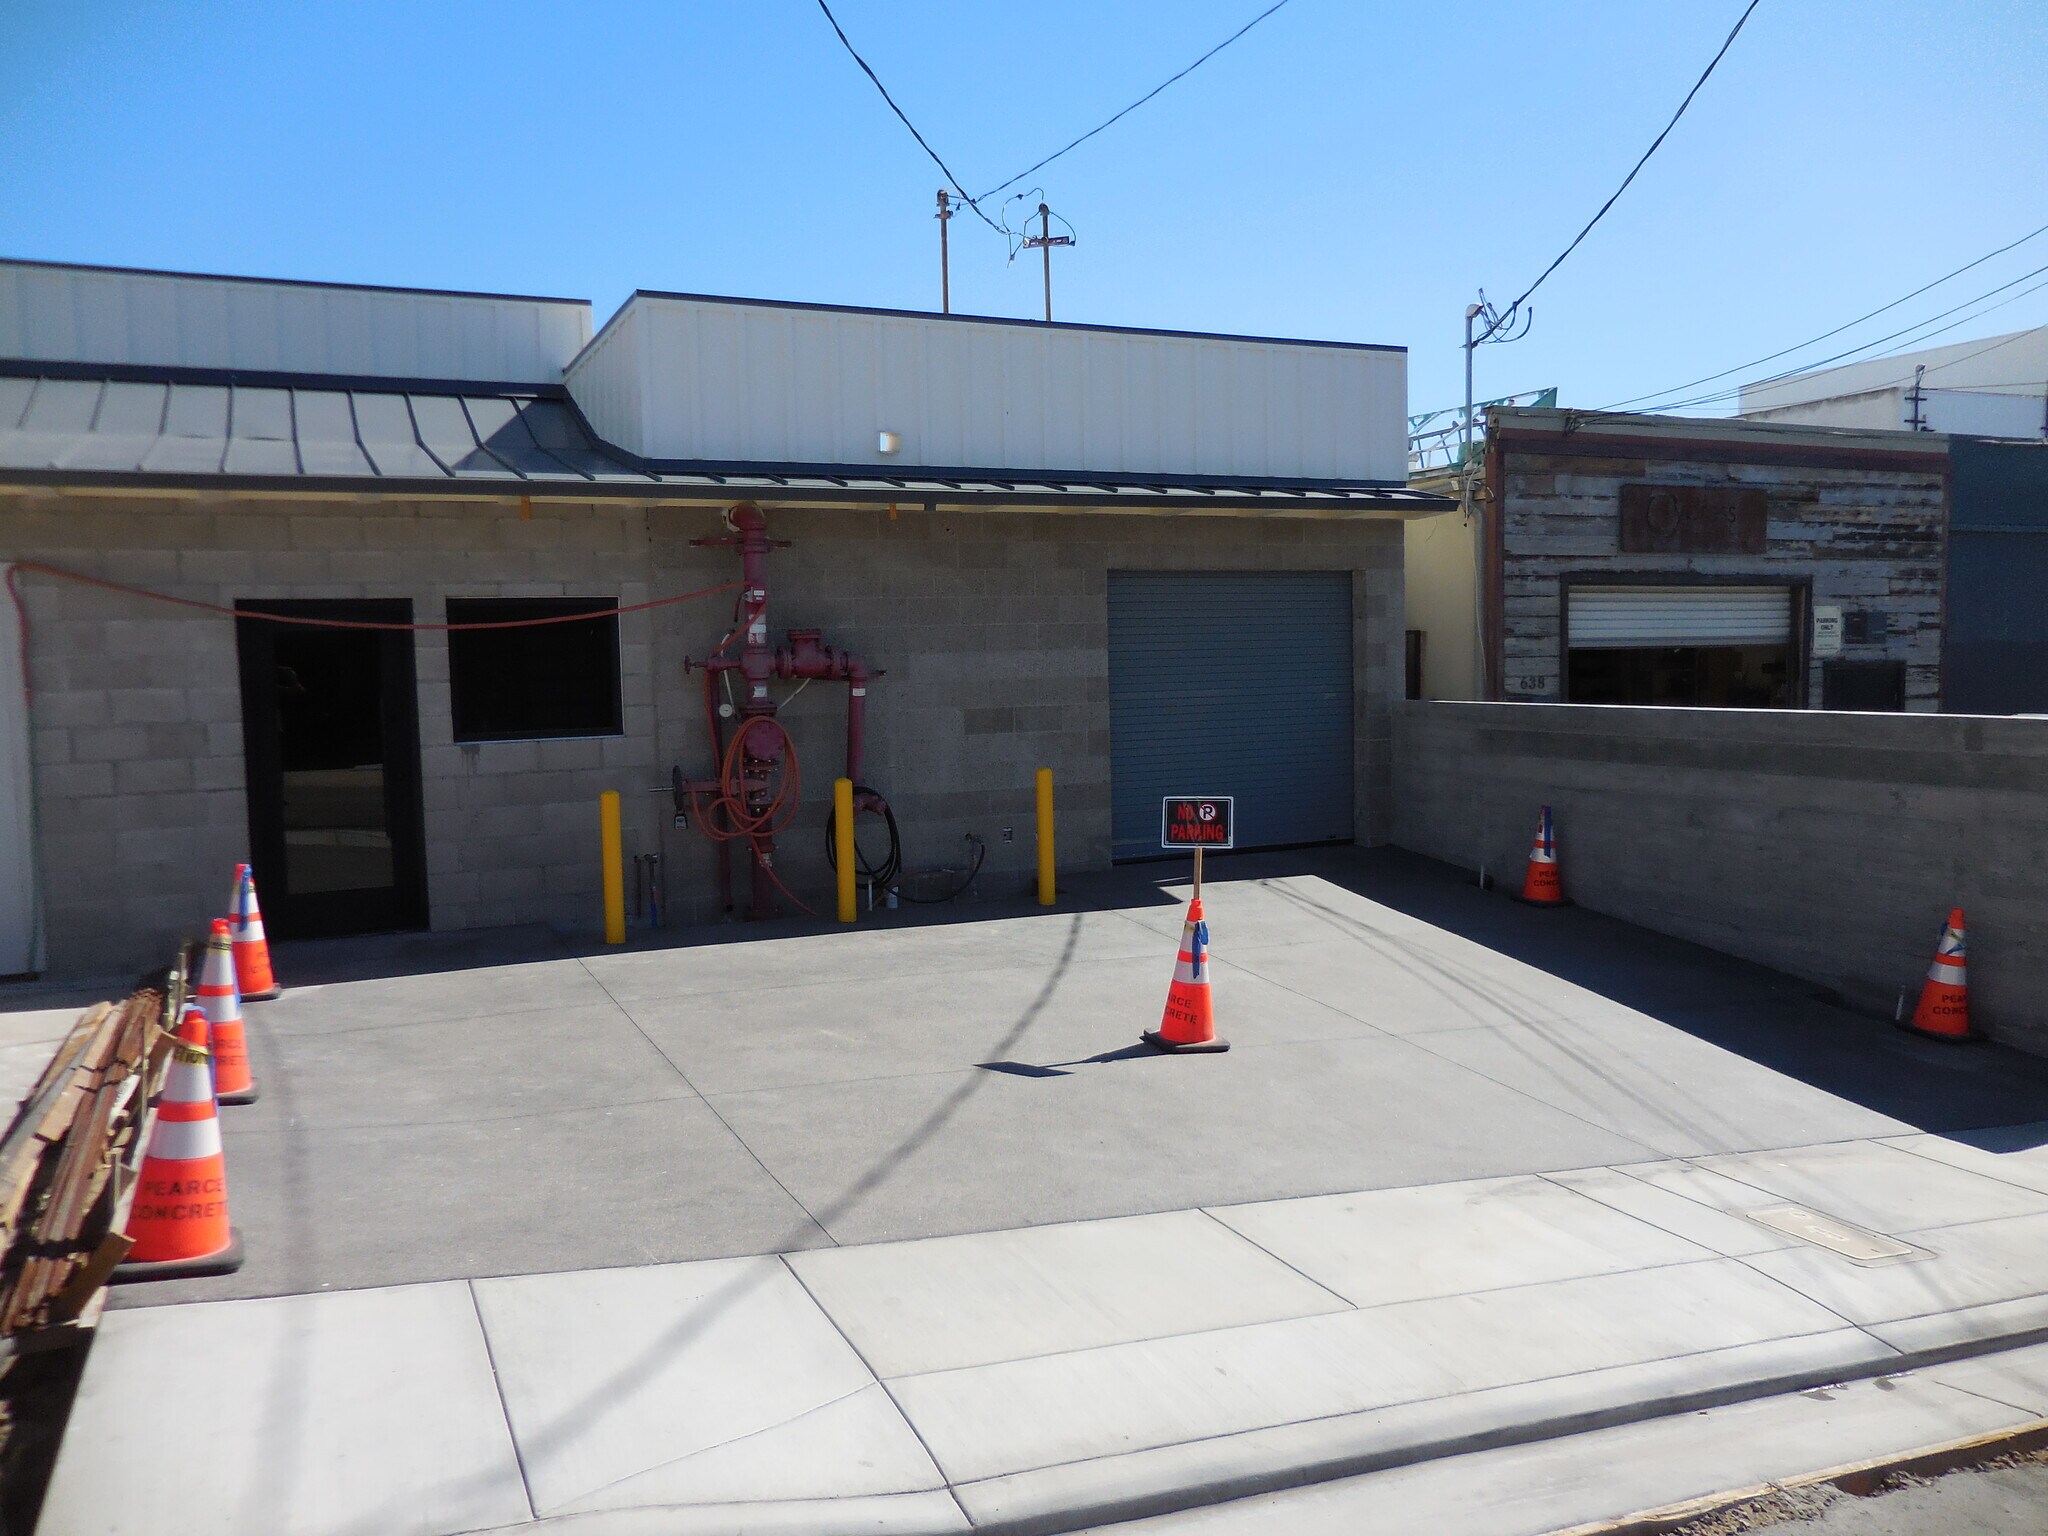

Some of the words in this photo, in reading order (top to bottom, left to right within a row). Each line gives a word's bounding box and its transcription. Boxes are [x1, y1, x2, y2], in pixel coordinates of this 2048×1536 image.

[1520, 676, 1545, 690] 638
[1177, 803, 1195, 820] NO
[1170, 823, 1224, 842] PARKING
